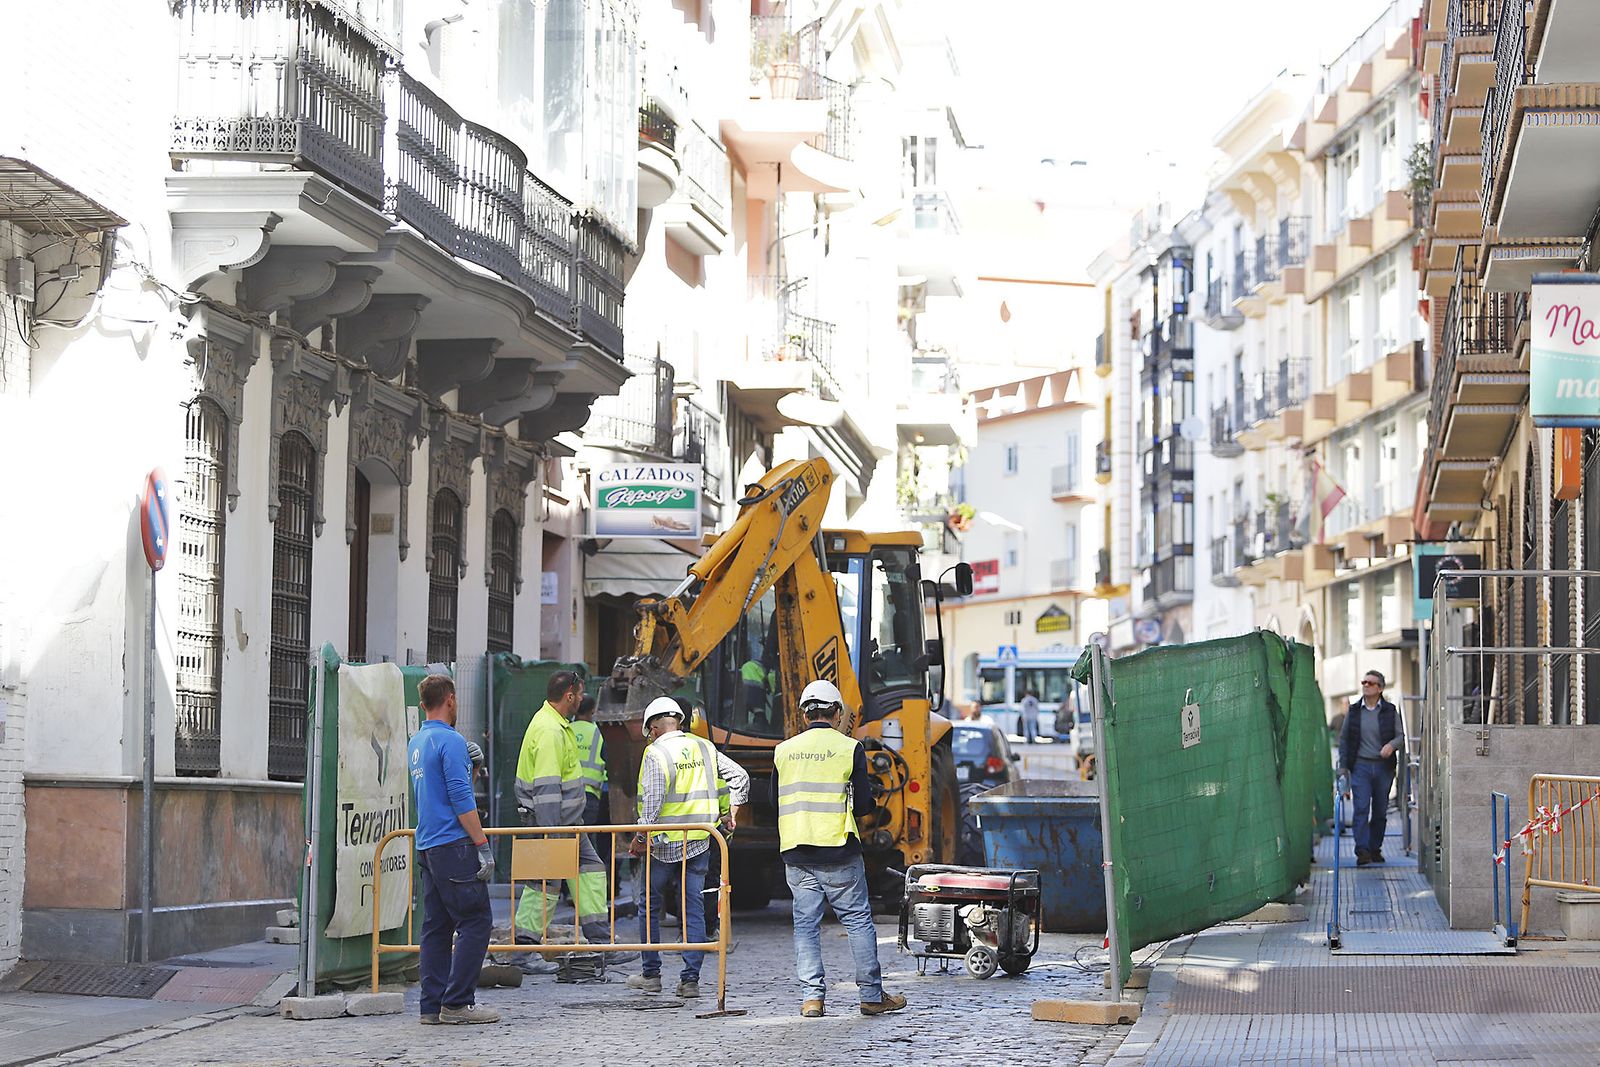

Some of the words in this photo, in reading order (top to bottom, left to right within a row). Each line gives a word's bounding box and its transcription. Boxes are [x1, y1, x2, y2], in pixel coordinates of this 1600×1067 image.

[599, 467, 695, 483] CALZADOS
[816, 647, 837, 688] JC
[788, 751, 826, 762] Naturgy
